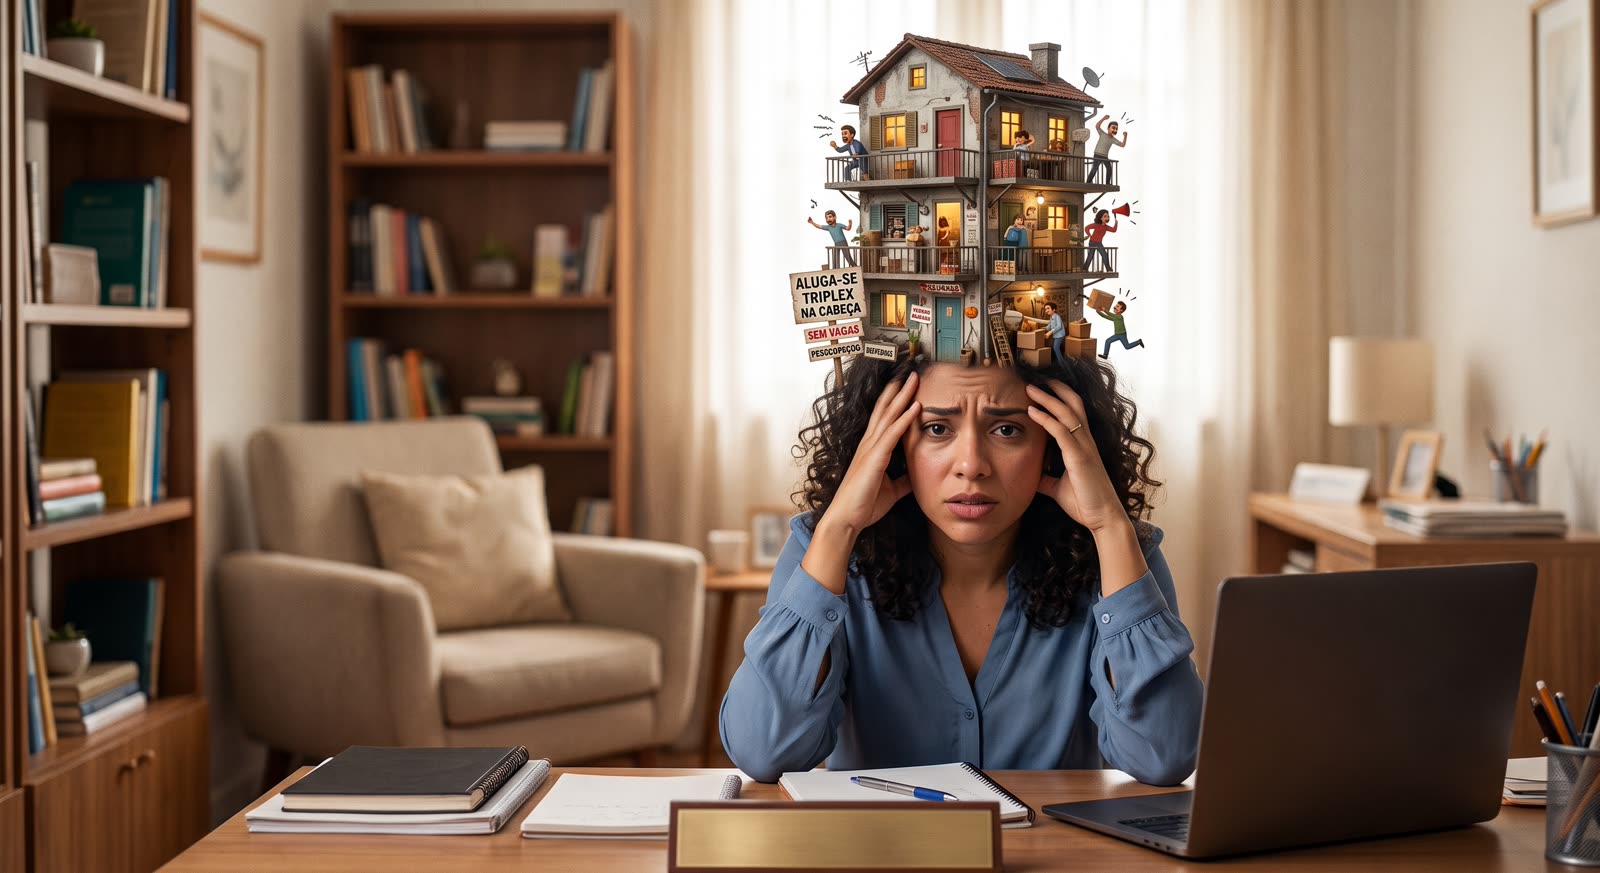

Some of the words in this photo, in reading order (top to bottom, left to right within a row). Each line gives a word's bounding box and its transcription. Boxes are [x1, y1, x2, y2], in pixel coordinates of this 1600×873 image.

[796, 272, 858, 290] ALUGA-SE
[802, 288, 854, 304] TRIPLEX
[801, 307, 816, 318] NA
[819, 302, 861, 316] CABEÇA
[808, 328, 827, 340] SEM
[829, 325, 859, 338] VAGAS
